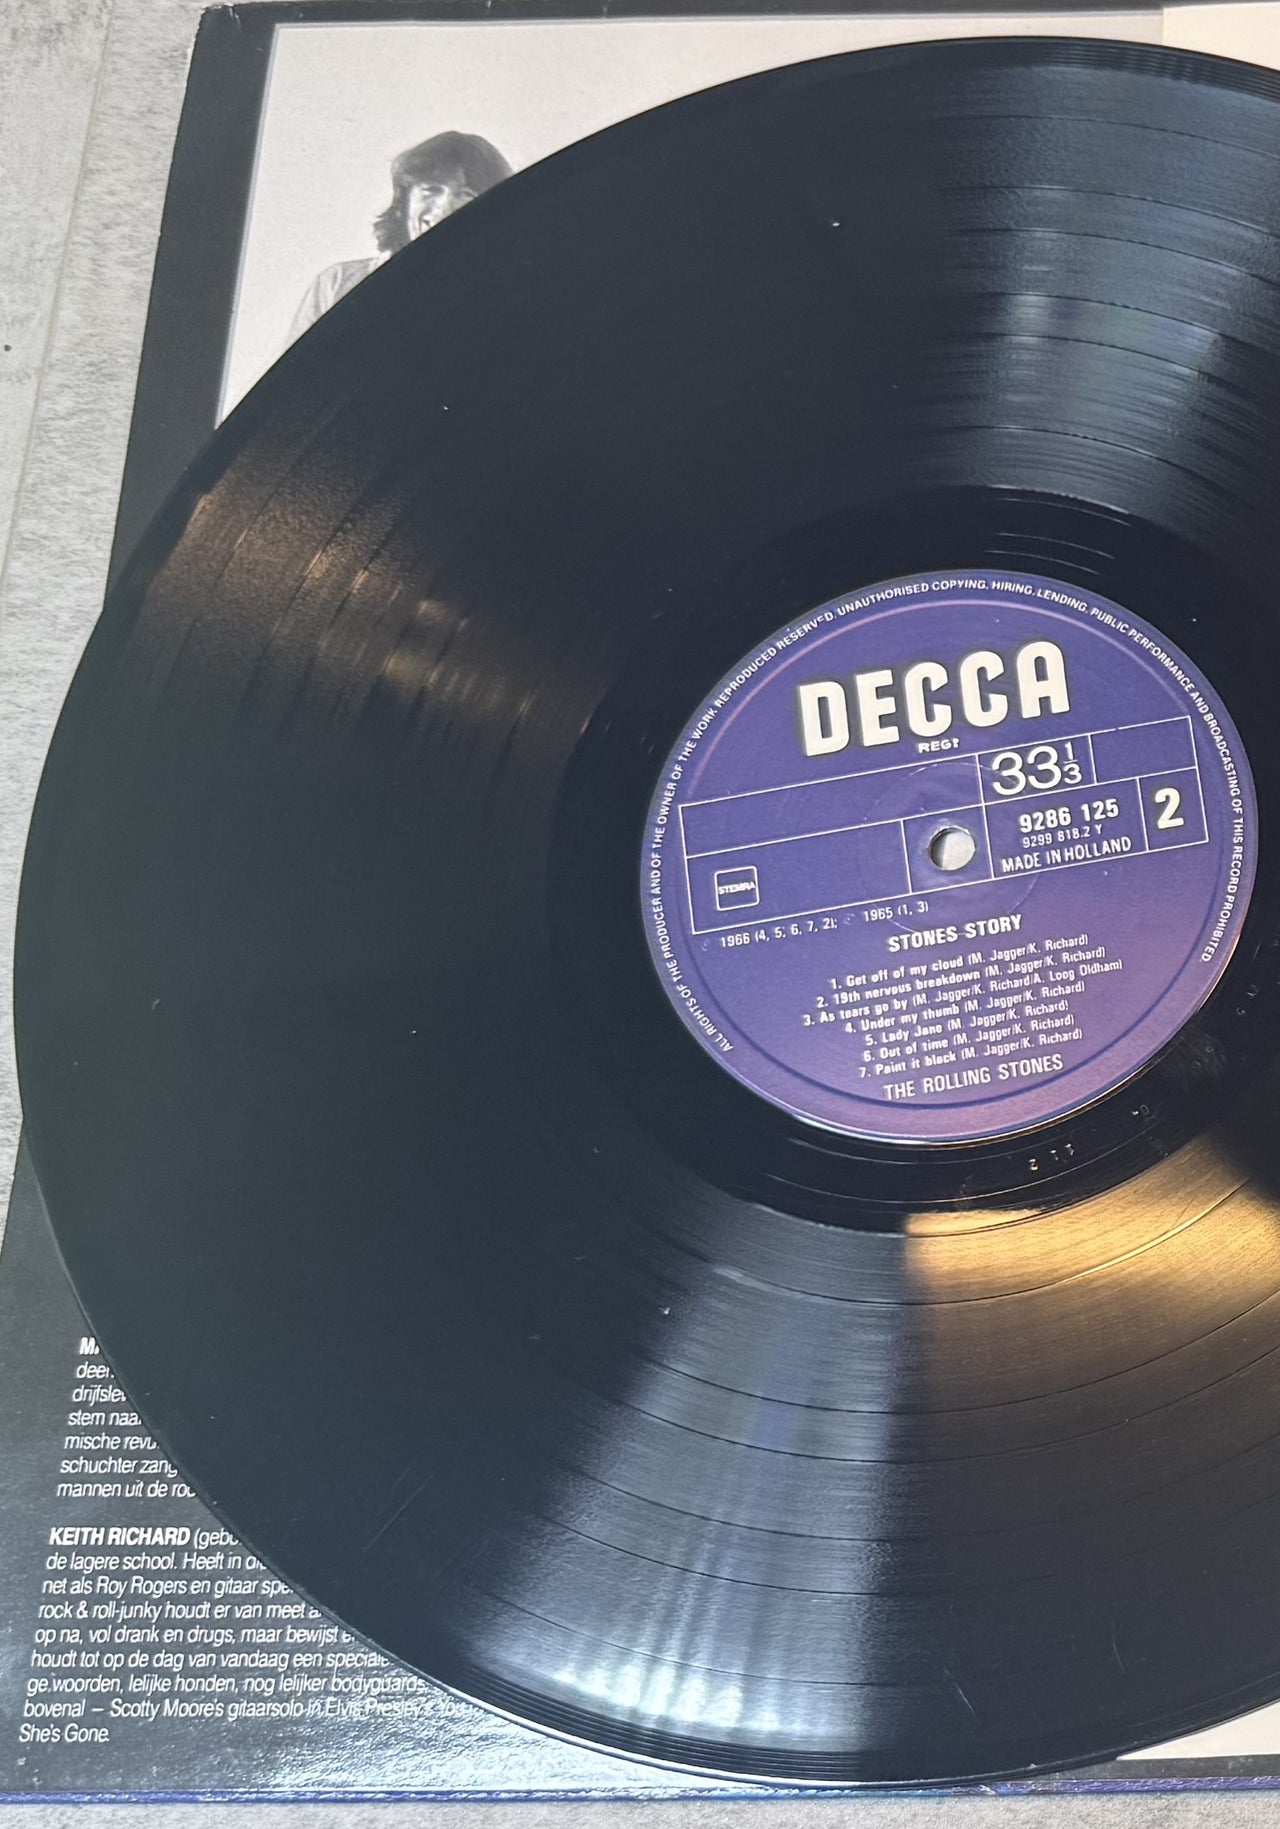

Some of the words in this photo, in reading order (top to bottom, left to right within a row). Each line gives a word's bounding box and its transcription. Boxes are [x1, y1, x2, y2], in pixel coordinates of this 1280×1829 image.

[838, 582, 930, 617] UNAUTHORISED
[1090, 607, 1129, 633] PUBLIC
[1128, 629, 1195, 691] PERFORMANCE
[714, 647, 777, 708] REPRODUCED
[799, 640, 1071, 757] DECCA
[1204, 714, 1240, 796] BROADCASTING
[1018, 807, 1072, 833] 9286
[1081, 798, 1119, 822] 125
[1154, 787, 1185, 829] 2
[1022, 832, 1053, 848] 9299
[1001, 851, 1042, 873] MADE
[1046, 847, 1062, 864] IN
[1066, 836, 1132, 861] HOLLAND
[1227, 845, 1243, 892] RECORD
[888, 925, 958, 953] STONES
[965, 914, 1023, 939] STORY
[1201, 895, 1235, 962] PROHIBITED
[721, 933, 750, 948] 1966
[884, 1080, 916, 1101] THE
[923, 1066, 991, 1094] ROLLING
[998, 1053, 1064, 1082] STONES
[64, 1433, 121, 1449] mische
[60, 1456, 137, 1473] schuchter
[56, 1482, 121, 1497] mannen
[125, 1480, 144, 1497] uit
[148, 1480, 169, 1497] de
[49, 1527, 104, 1545] KEITH
[108, 1527, 190, 1545] RICHARD
[47, 1552, 67, 1569] de
[70, 1552, 119, 1573] lagere
[183, 1552, 224, 1569] Heeft
[42, 1577, 67, 1594] net
[70, 1577, 93, 1594] als
[96, 1577, 127, 1598] Roy
[130, 1577, 187, 1598] Rogers
[215, 1576, 259, 1598] gitaar
[38, 1601, 73, 1618] rock
[92, 1601, 162, 1623] roll-junky
[165, 1601, 210, 1618] houdt
[234, 1604, 262, 1618] van
[35, 1628, 56, 1646] op
[89, 1625, 112, 1643] vol
[115, 1625, 159, 1643] drank
[188, 1625, 236, 1647] drugs,
[241, 1628, 283, 1642] maar
[286, 1626, 337, 1646] bewijst
[31, 1650, 77, 1668] houdt
[80, 1650, 100, 1668] tot
[103, 1653, 124, 1671] op
[128, 1650, 149, 1667] de
[153, 1650, 184, 1671] dag
[188, 1653, 216, 1668] van
[221, 1650, 289, 1670] vandaag
[293, 1653, 322, 1667] een
[129, 1675, 171, 1696] lelijke
[175, 1675, 238, 1693] honden,
[244, 1677, 275, 1695] nog
[279, 1674, 325, 1696] lelijker
[24, 1699, 85, 1717] bovenal
[110, 1699, 160, 1721] Scotty
[163, 1699, 224, 1717] Moore's
[18, 1723, 61, 1743] She's
